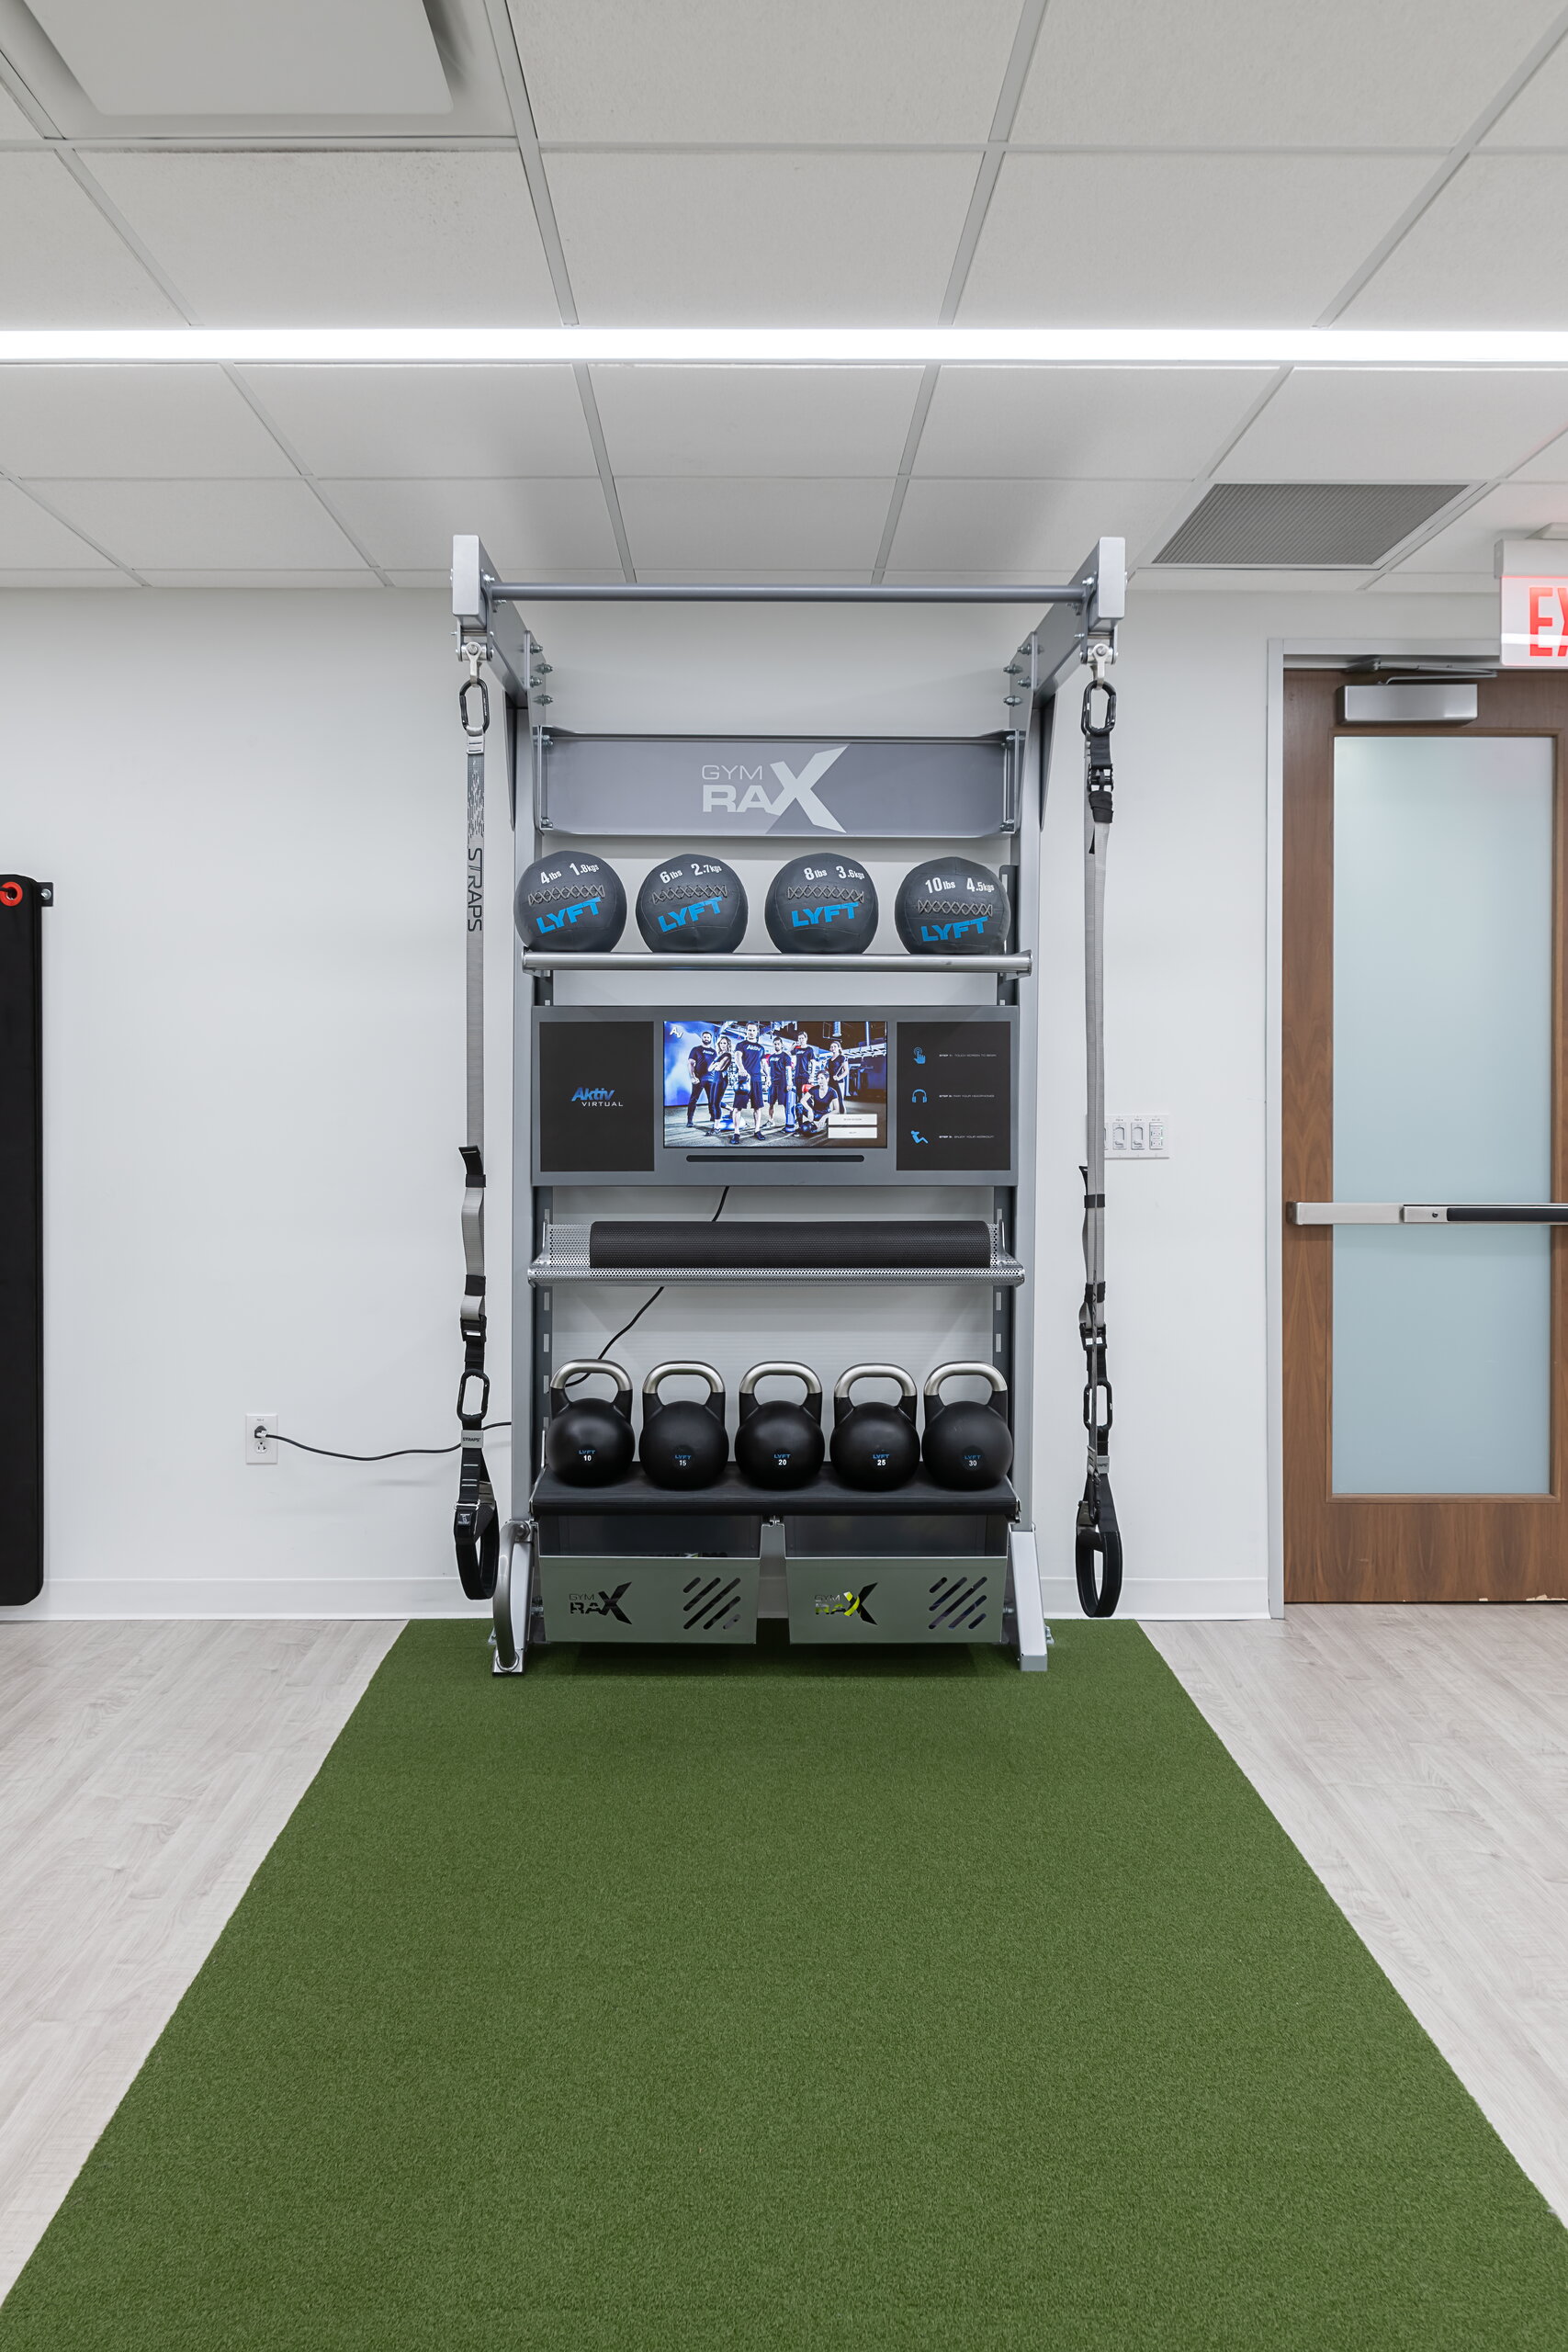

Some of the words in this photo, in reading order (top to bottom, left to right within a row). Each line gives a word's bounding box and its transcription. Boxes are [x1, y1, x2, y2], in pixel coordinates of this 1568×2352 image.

[702, 764, 762, 780] GYM
[703, 745, 848, 833] RAX
[540, 869, 562, 885] 4lbs
[569, 862, 600, 876] 1.8kgs
[660, 867, 682, 884] 6lbs
[691, 863, 722, 876] 2.7kgs
[804, 867, 828, 881] 8lbs
[836, 865, 865, 880] 3.6kgs
[468, 847, 482, 932] STRAPS
[925, 877, 956, 894] 10lbs
[966, 877, 995, 893] 4.5kgs
[536, 897, 602, 934] LYFT
[658, 896, 723, 933] LYFT
[791, 901, 859, 928] LYFT
[920, 916, 988, 942] LYFT
[571, 1087, 615, 1102] Aktiv
[570, 1581, 633, 1625] RAX
[814, 1594, 841, 1602] GYM
